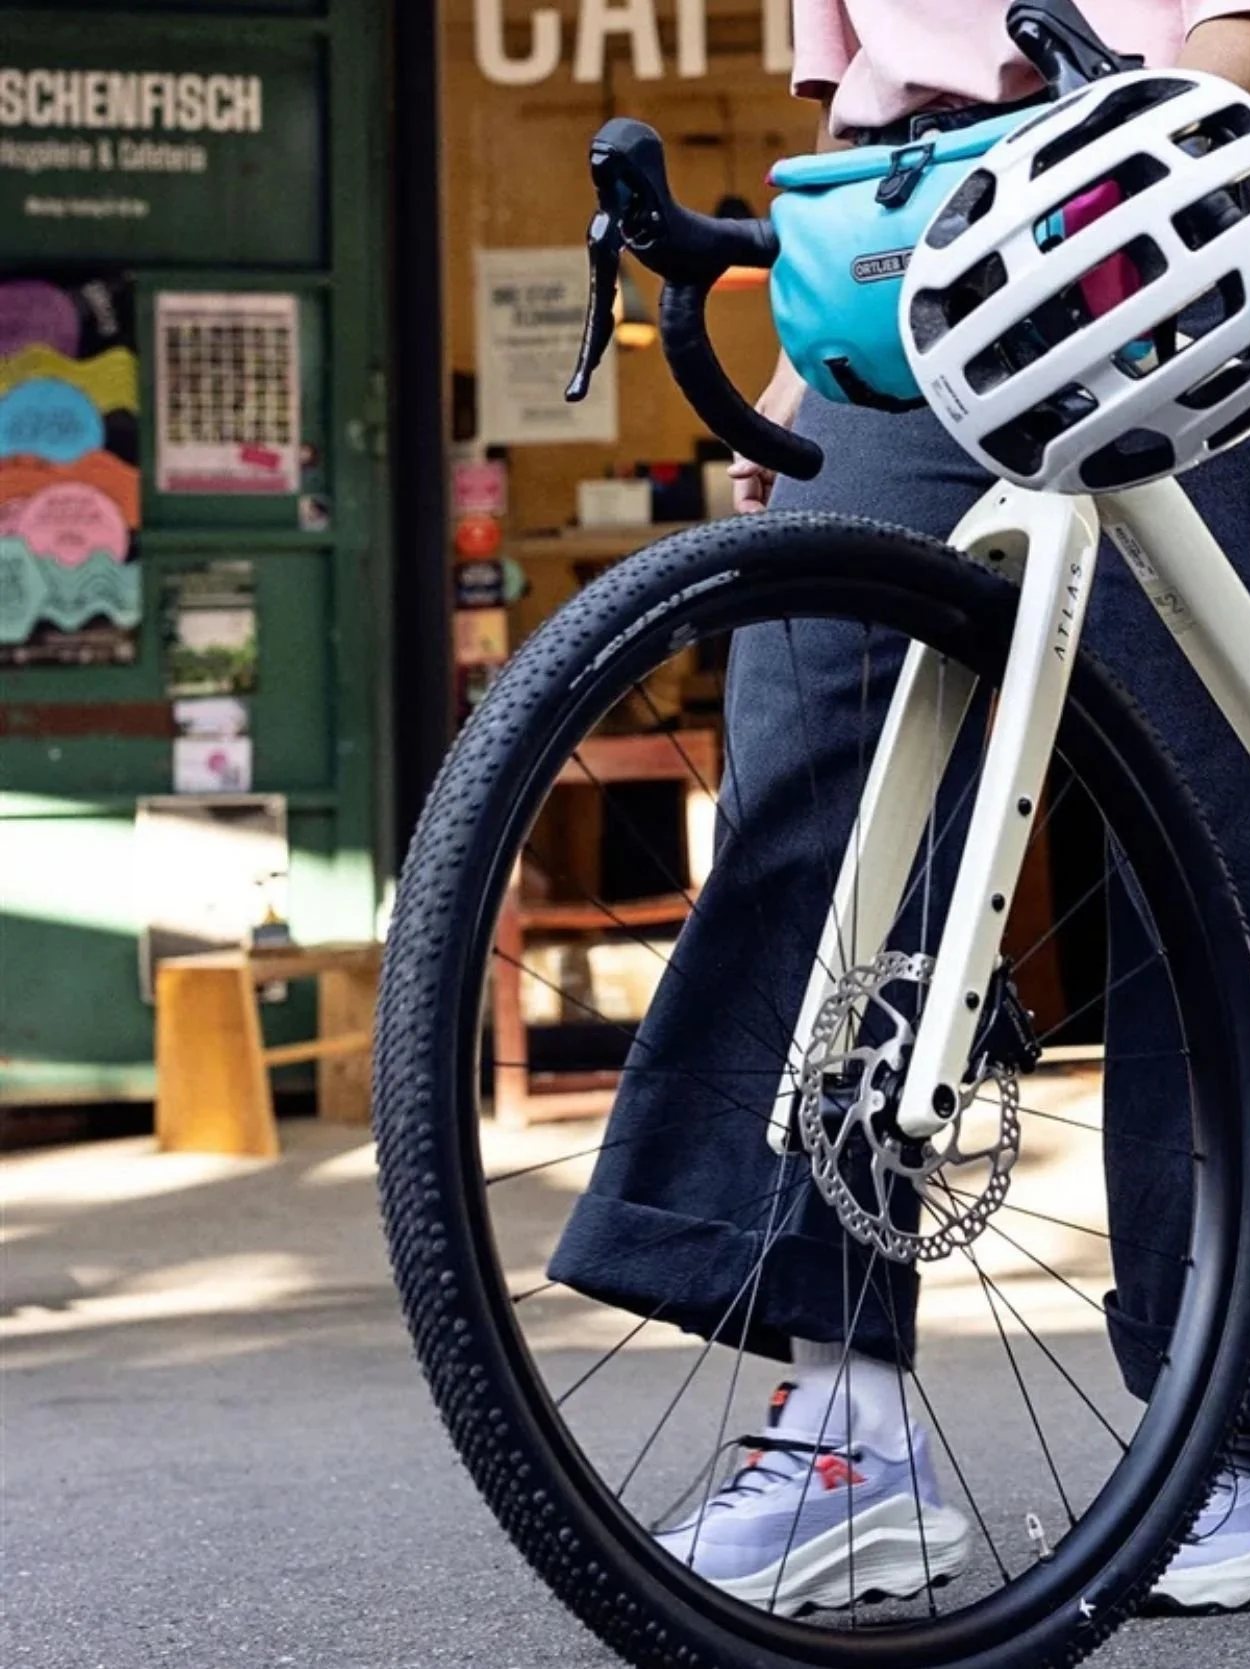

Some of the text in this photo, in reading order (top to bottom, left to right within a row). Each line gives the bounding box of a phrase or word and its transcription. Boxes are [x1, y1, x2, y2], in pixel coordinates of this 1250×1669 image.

[475, 0, 795, 85] CA
[0, 68, 263, 133] SCHENFISCH
[1053, 561, 1083, 662] ATLAS
